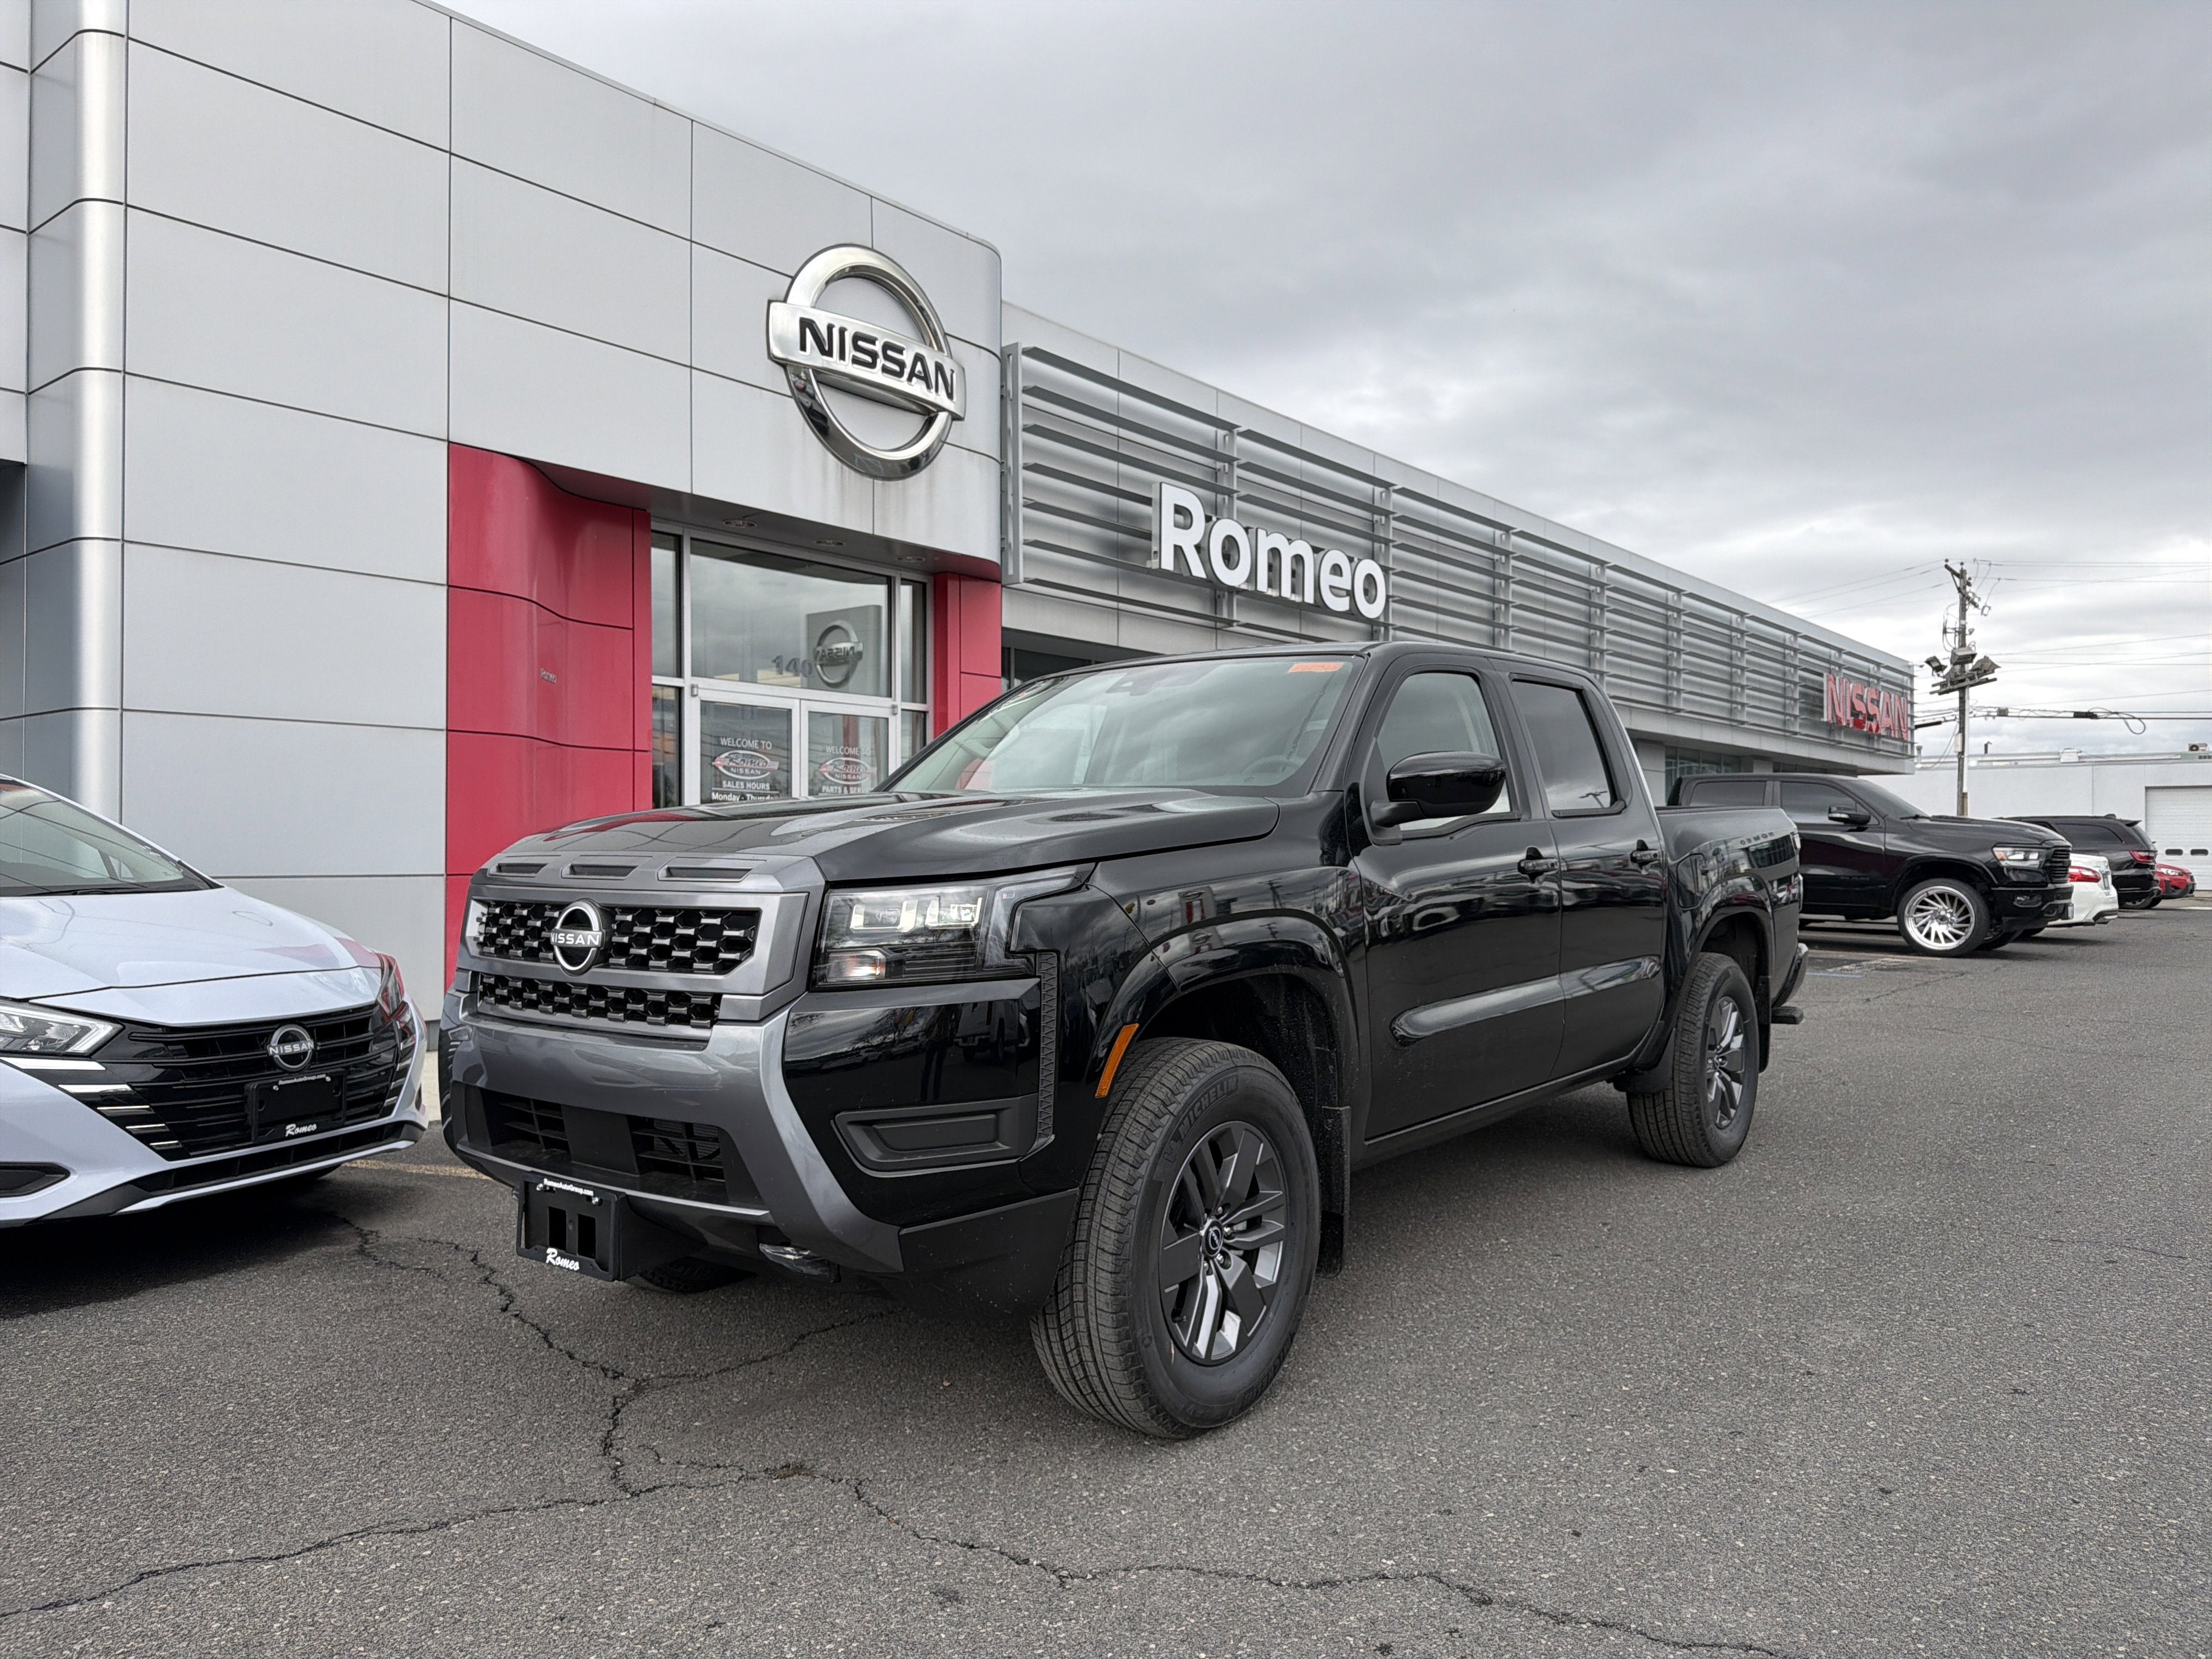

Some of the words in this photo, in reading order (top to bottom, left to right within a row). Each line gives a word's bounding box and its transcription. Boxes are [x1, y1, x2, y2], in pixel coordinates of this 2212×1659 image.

[799, 317, 955, 400] NISSAN
[1160, 482, 1386, 619] Romeo
[1826, 673, 1909, 741] NISSAN
[720, 737, 759, 749] WELCOME
[761, 741, 772, 749] TO
[826, 745, 860, 755] WELCOME
[722, 780, 744, 789] SALES
[747, 781, 770, 790] HOURS
[822, 785, 842, 793] PARTS
[843, 786, 848, 794] &
[712, 792, 741, 802] Monday
[551, 933, 600, 945] NISSAN
[269, 1041, 314, 1055] NISSAN
[1179, 1077, 1238, 1140] MICHELIN
[285, 1124, 317, 1137] Romeo
[544, 1178, 594, 1197] RomeoAutoGroup.com
[546, 1248, 580, 1271] Romeo
